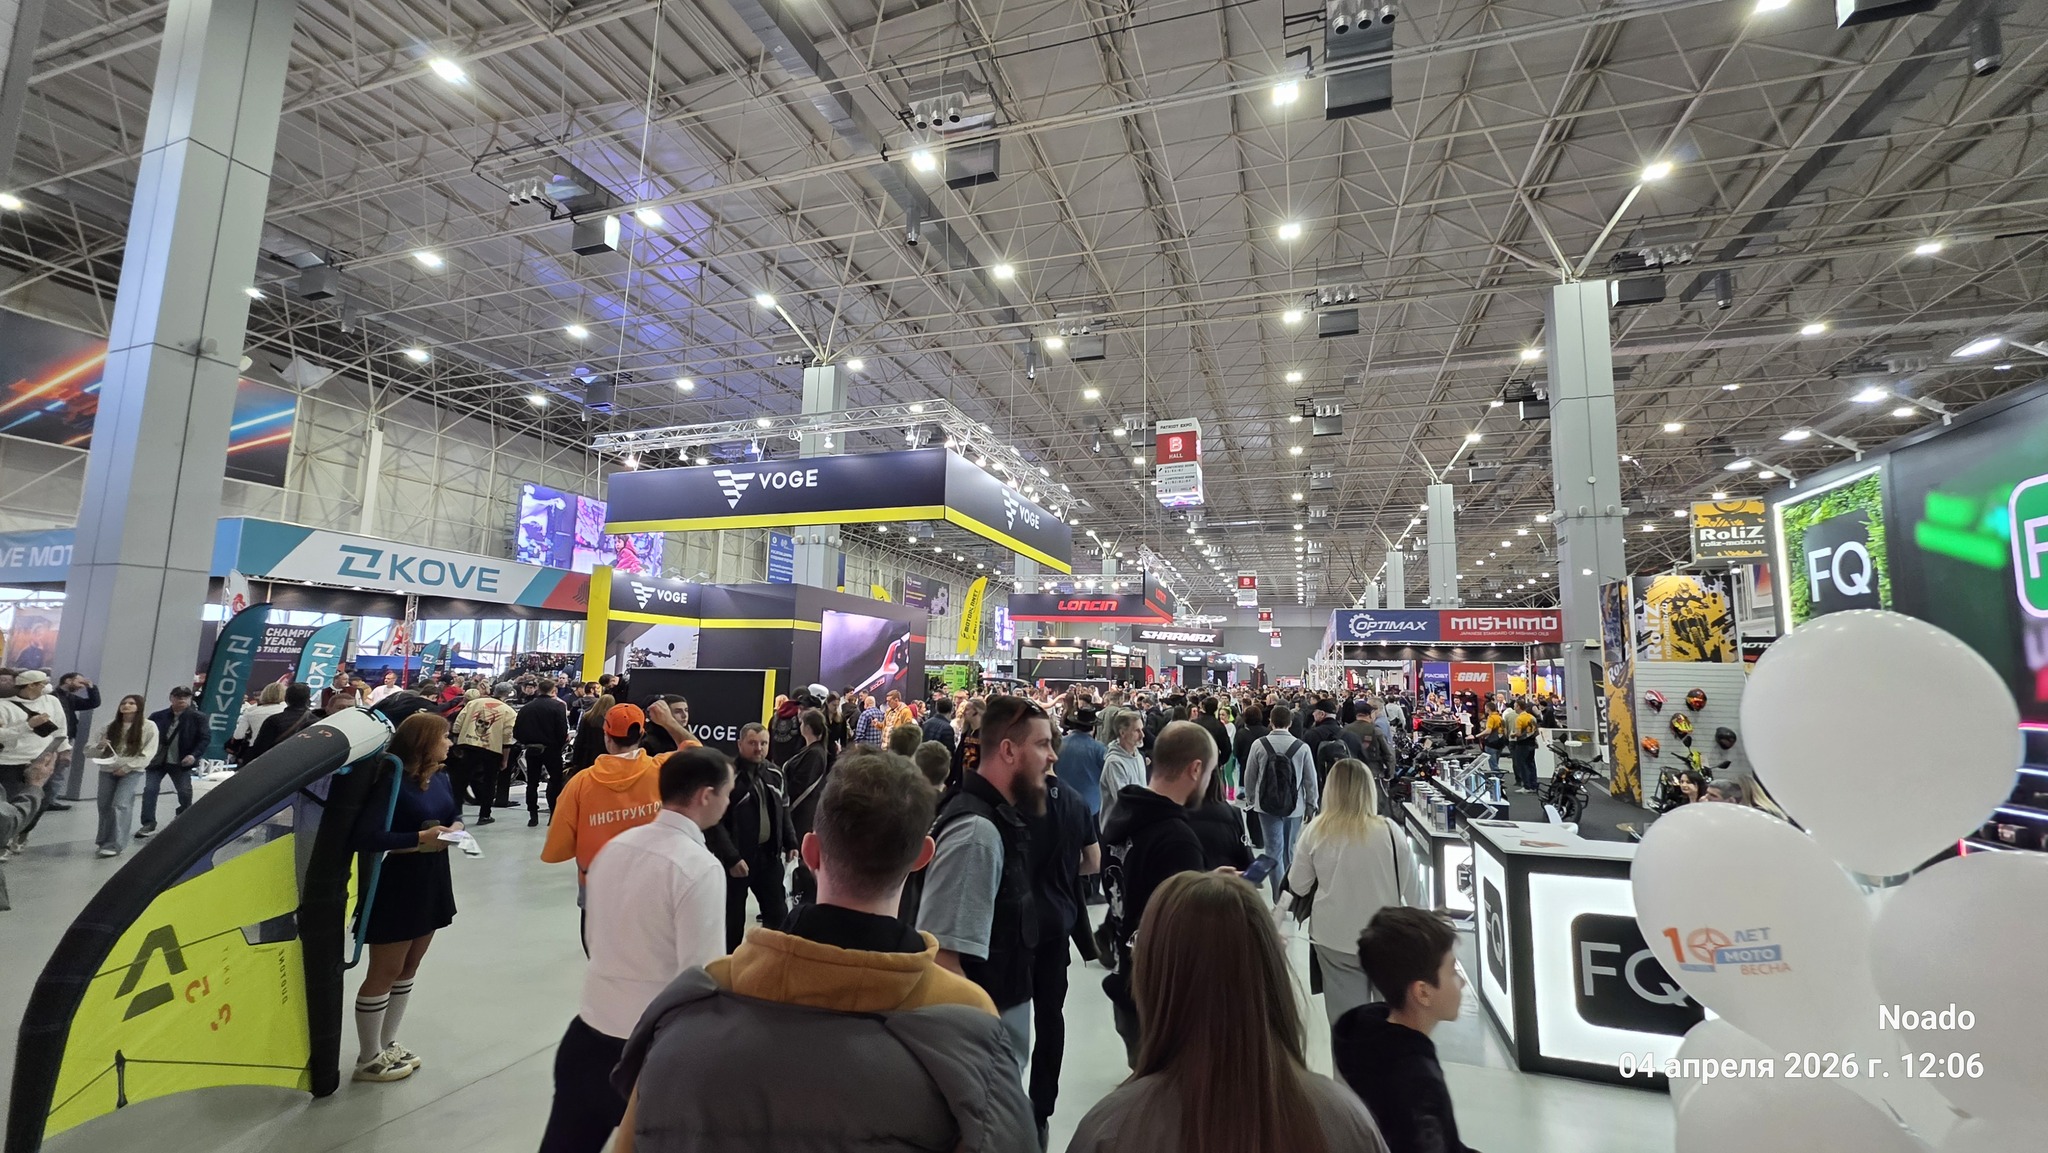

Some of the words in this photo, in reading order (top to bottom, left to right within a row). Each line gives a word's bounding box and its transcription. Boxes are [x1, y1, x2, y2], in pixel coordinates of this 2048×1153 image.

[1169, 436, 1182, 452] B
[759, 469, 818, 490] VOGE
[1019, 504, 1040, 530] VOGE
[1700, 539, 1766, 547] roliz-moto.ru
[388, 553, 500, 594] KOVE
[1807, 541, 1871, 603] FQ
[656, 589, 688, 604] VOGE
[1058, 600, 1118, 612] LONCIN
[1356, 620, 1428, 631] OPTIMAX
[1450, 615, 1558, 631] MISHIMO
[264, 636, 297, 646] YEAR:
[1139, 629, 1217, 643] SHARMAX
[1457, 672, 1488, 682] GBM
[208, 660, 243, 731] KOVE
[688, 724, 737, 741] VOGE
[589, 800, 663, 826] ИНСТРУКТО
[1734, 927, 1771, 943] ЛЕТ
[1724, 948, 1776, 962] МОТО
[1580, 941, 1689, 1007] FQ
[1739, 962, 1793, 975] ВЕСНА
